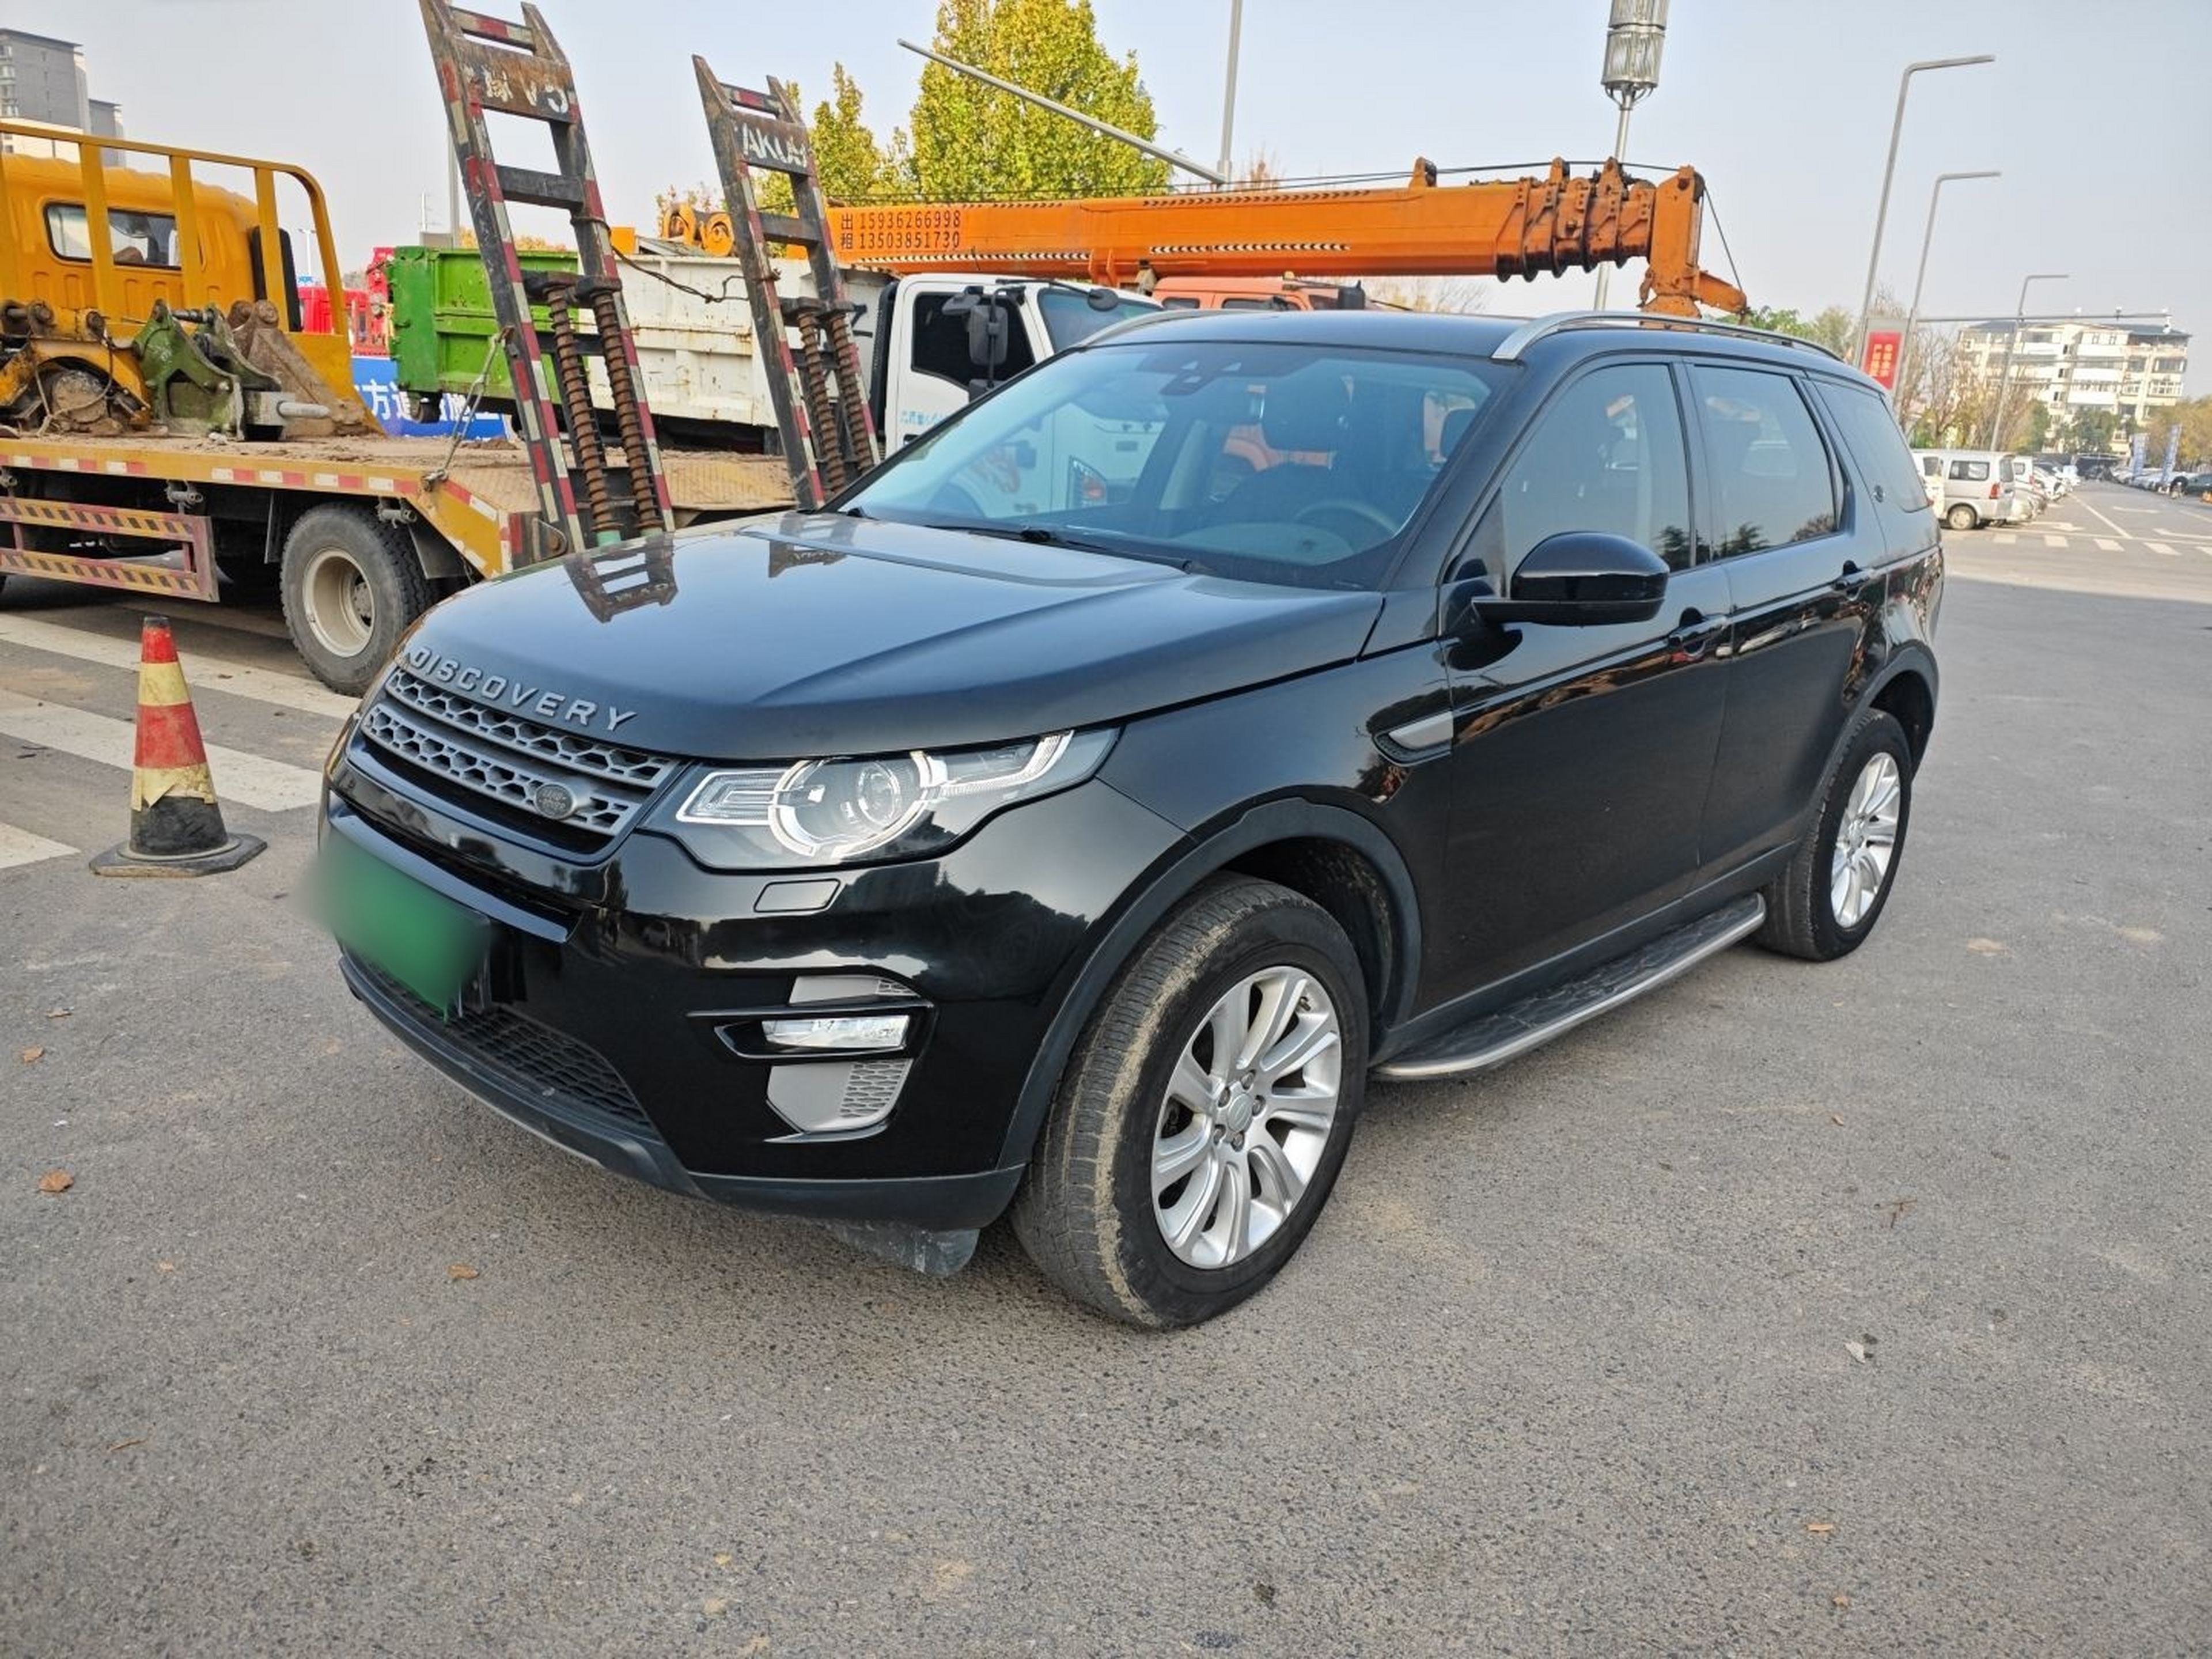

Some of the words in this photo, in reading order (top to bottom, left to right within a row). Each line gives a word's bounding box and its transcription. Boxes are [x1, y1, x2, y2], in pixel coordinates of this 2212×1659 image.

[859, 210, 961, 229] 15936266998
[859, 231, 960, 249] 13503851730
[410, 647, 638, 731] DISCOVERY
